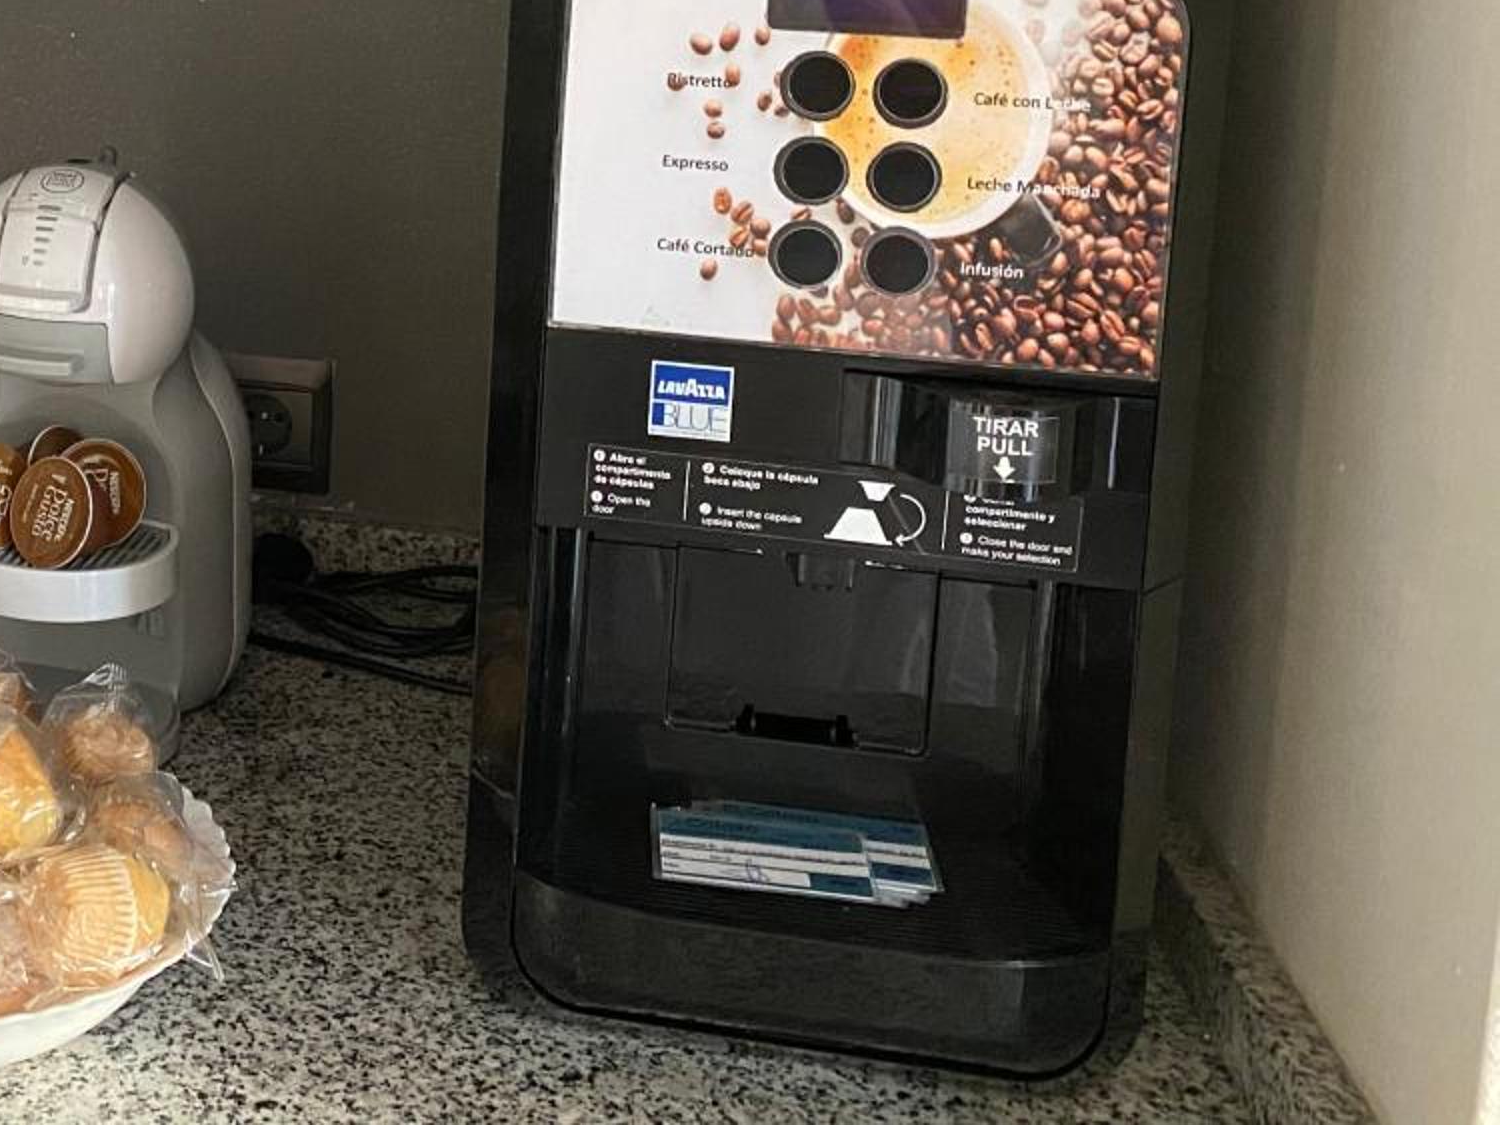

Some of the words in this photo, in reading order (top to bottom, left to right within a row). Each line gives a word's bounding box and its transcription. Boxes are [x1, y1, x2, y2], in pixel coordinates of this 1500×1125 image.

[667, 72, 732, 88] Ristretto
[973, 92, 1009, 107] Café
[1013, 97, 1041, 109] con
[662, 154, 729, 172] Expresso
[967, 176, 1012, 192] Leche
[1017, 180, 1101, 199] Manchada
[657, 238, 690, 252] Café
[694, 241, 755, 258] Cortado
[960, 261, 1024, 280] Infusión
[657, 378, 725, 400] LAVAZZA
[663, 403, 728, 434] BLUE
[973, 416, 1039, 438] TIRAR
[977, 437, 1034, 456] PULL
[594, 475, 607, 484] de
[719, 465, 763, 478] Coloque
[766, 470, 775, 480] la
[732, 480, 761, 491] abajo
[1047, 513, 1055, 524] y
[978, 535, 1007, 548] Close
[1009, 539, 1025, 550] the
[1028, 541, 1051, 552] door
[1053, 545, 1074, 556] and
[991, 550, 1015, 560] your
